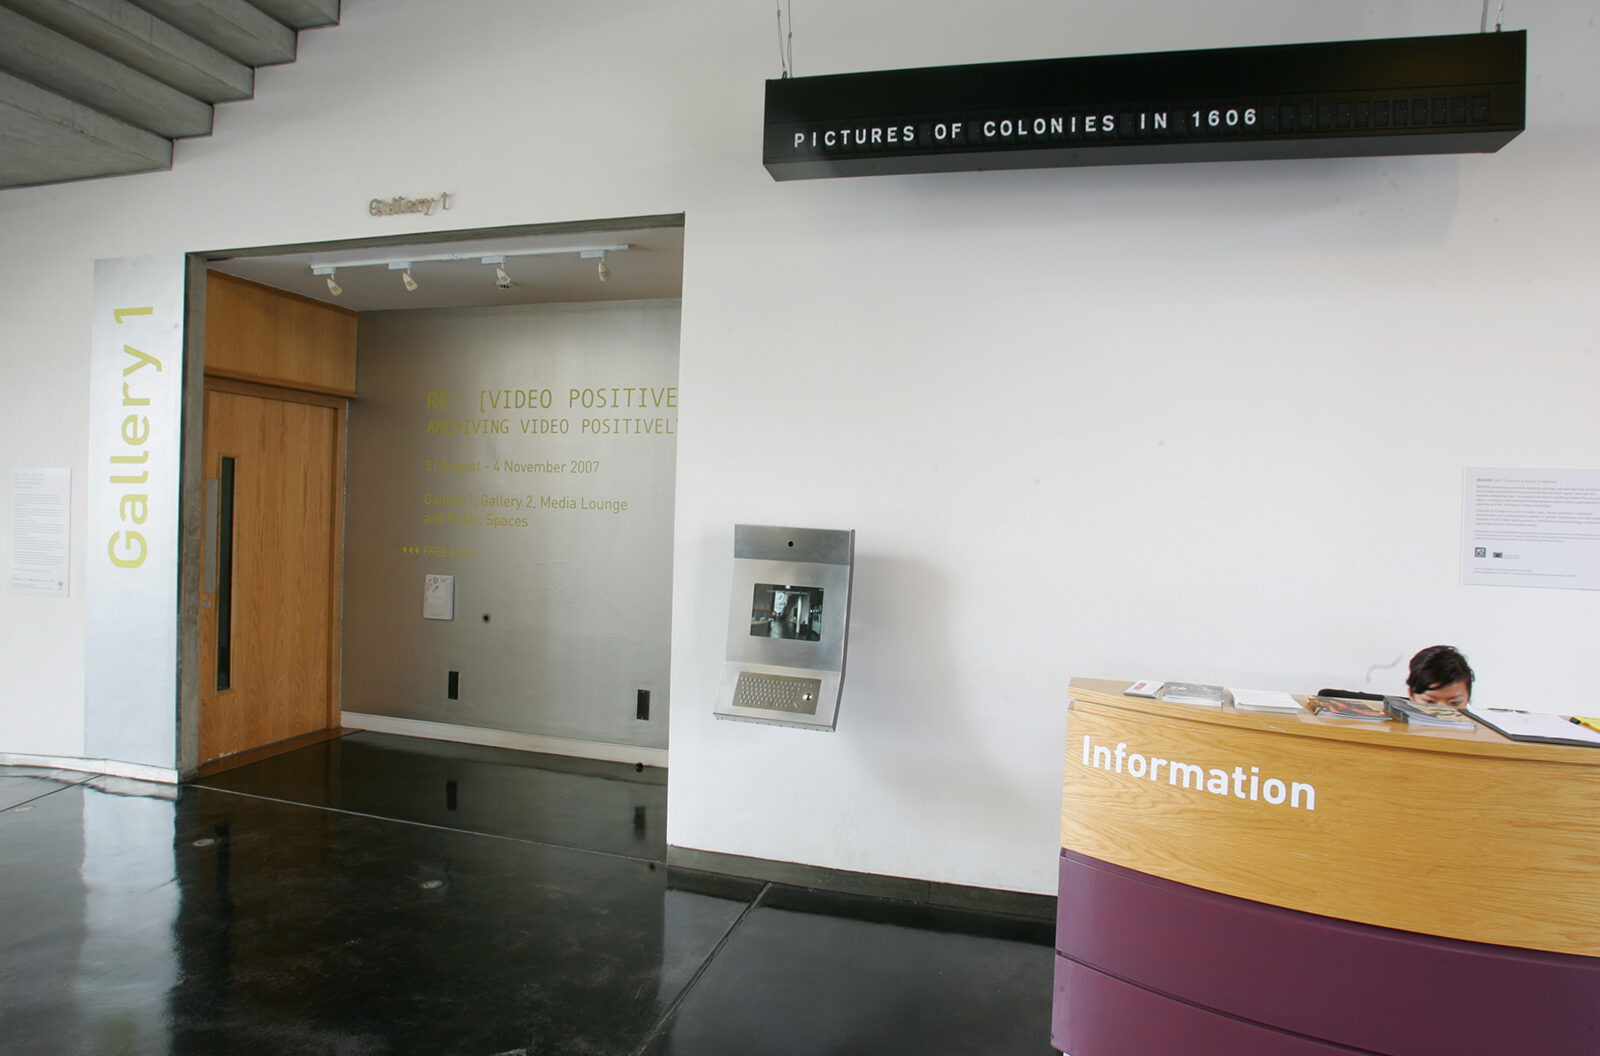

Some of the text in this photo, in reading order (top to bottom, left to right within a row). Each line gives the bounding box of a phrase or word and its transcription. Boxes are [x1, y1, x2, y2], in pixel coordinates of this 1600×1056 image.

[794, 108, 1258, 148] PICTURES OF COLONIES IN 1606
[369, 195, 434, 216] Gallery
[480, 389, 553, 412] [VIDEO
[569, 388, 677, 408] POSITIVE
[426, 418, 678, 434] ARCHIVING VIDEO POSITIVEL
[108, 305, 162, 569] Gallery 1
[425, 460, 438, 472] 31
[442, 461, 480, 475] August
[493, 461, 500, 471] 4
[504, 461, 565, 473] November
[570, 461, 600, 473] 2007
[424, 493, 464, 508] Gallery
[481, 494, 522, 510] Gallery
[526, 496, 536, 510] 2,
[540, 496, 576, 510] Media
[581, 497, 628, 514] Lounge
[424, 512, 528, 528] and Public Spaces
[423, 546, 446, 557] FREE
[1082, 735, 1315, 810] Information
